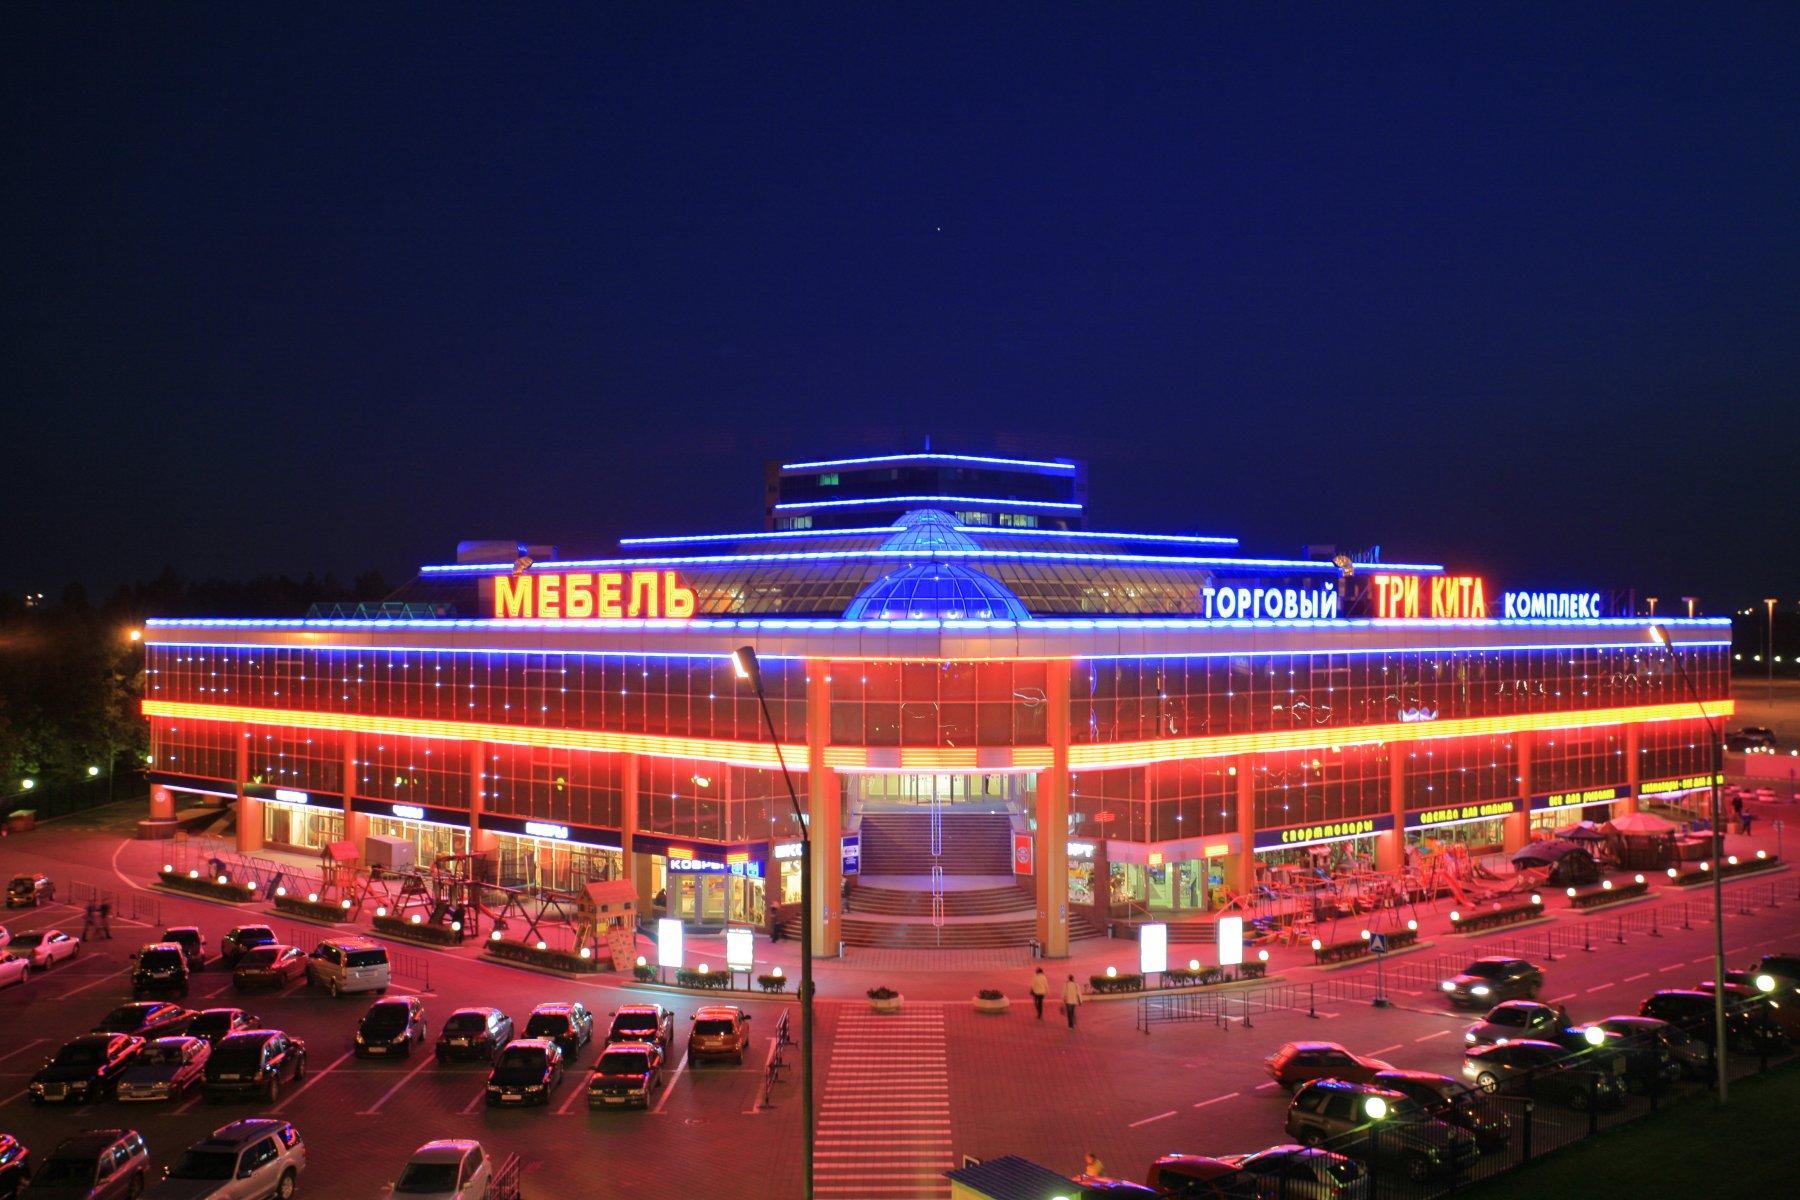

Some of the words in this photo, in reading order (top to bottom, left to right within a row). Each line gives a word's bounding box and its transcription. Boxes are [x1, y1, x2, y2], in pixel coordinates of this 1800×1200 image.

[494, 571, 696, 618] МЕБЕЛЬ
[1202, 582, 1338, 619] ТОРГОВЫЙ
[1375, 575, 1419, 618] ТРИ
[1431, 577, 1486, 618] КИТА
[1505, 592, 1600, 618] КОМПЛЕКС
